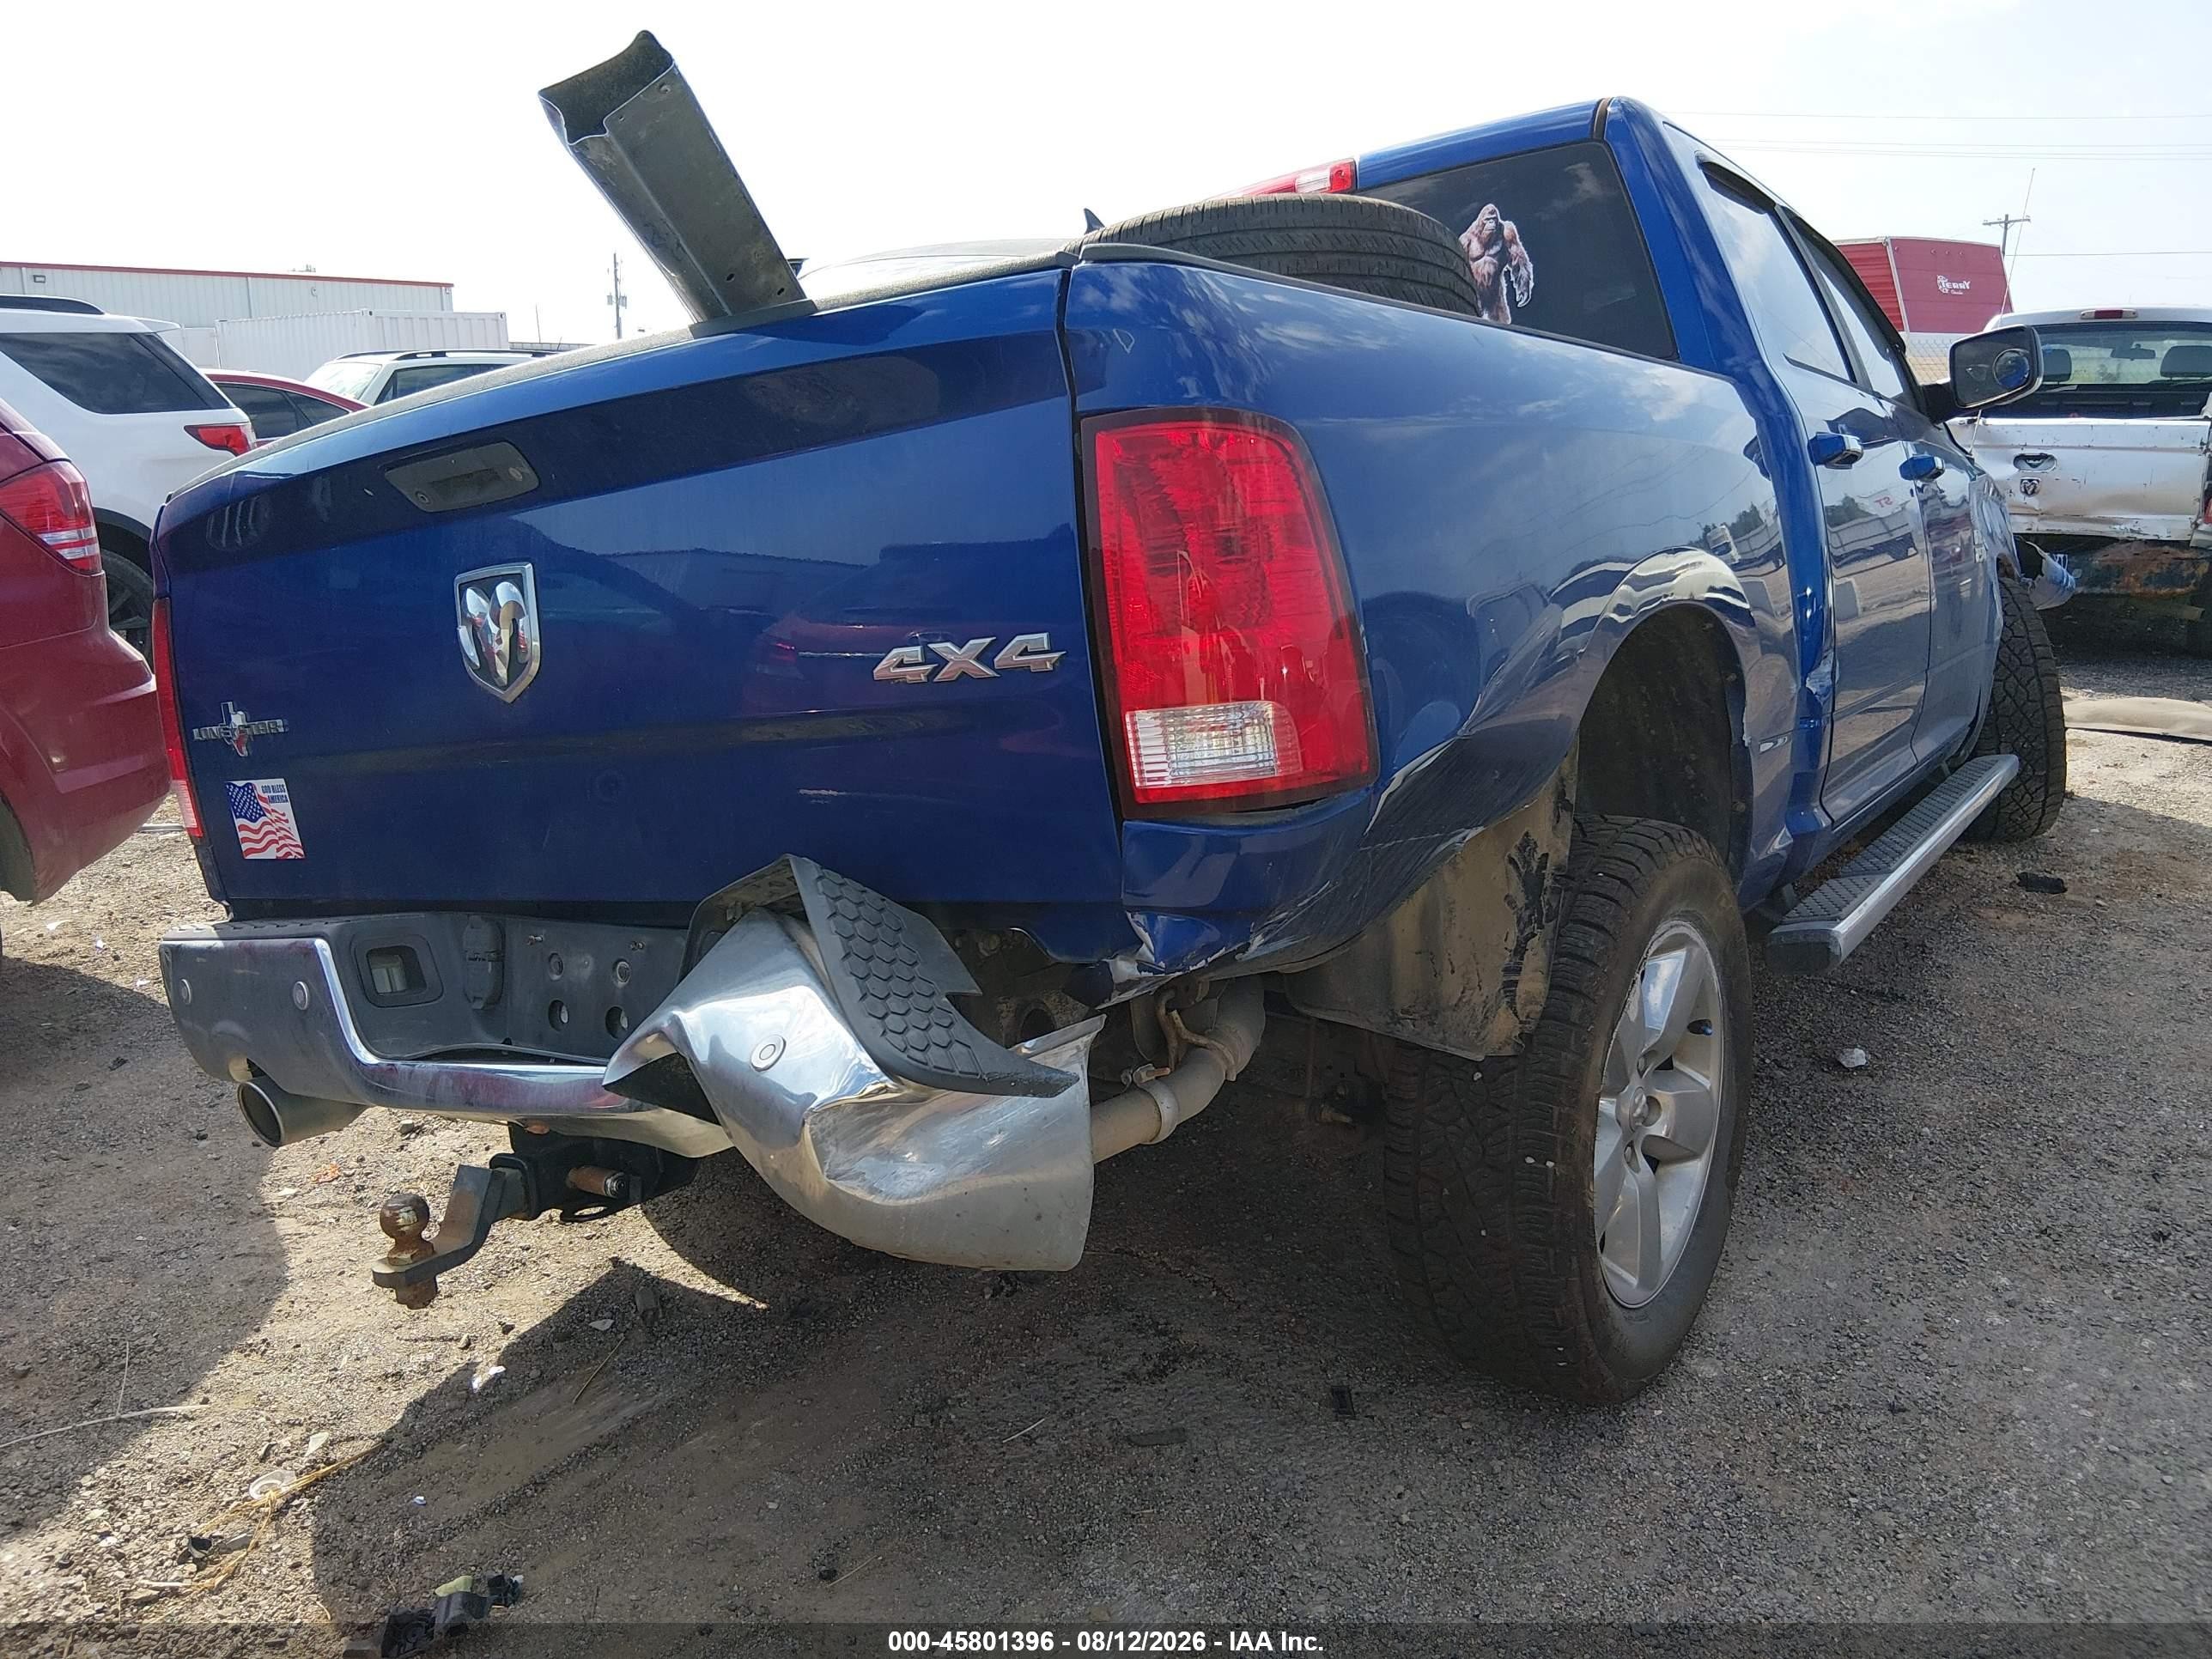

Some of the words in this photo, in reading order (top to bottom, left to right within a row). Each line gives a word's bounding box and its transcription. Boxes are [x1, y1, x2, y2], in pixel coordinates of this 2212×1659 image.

[1939, 279, 1971, 289] TERRY
[872, 632, 1066, 684] 4X4
[261, 785, 272, 794] GOD
[271, 783, 286, 794] BLESS
[268, 794, 289, 805] AMERICA
